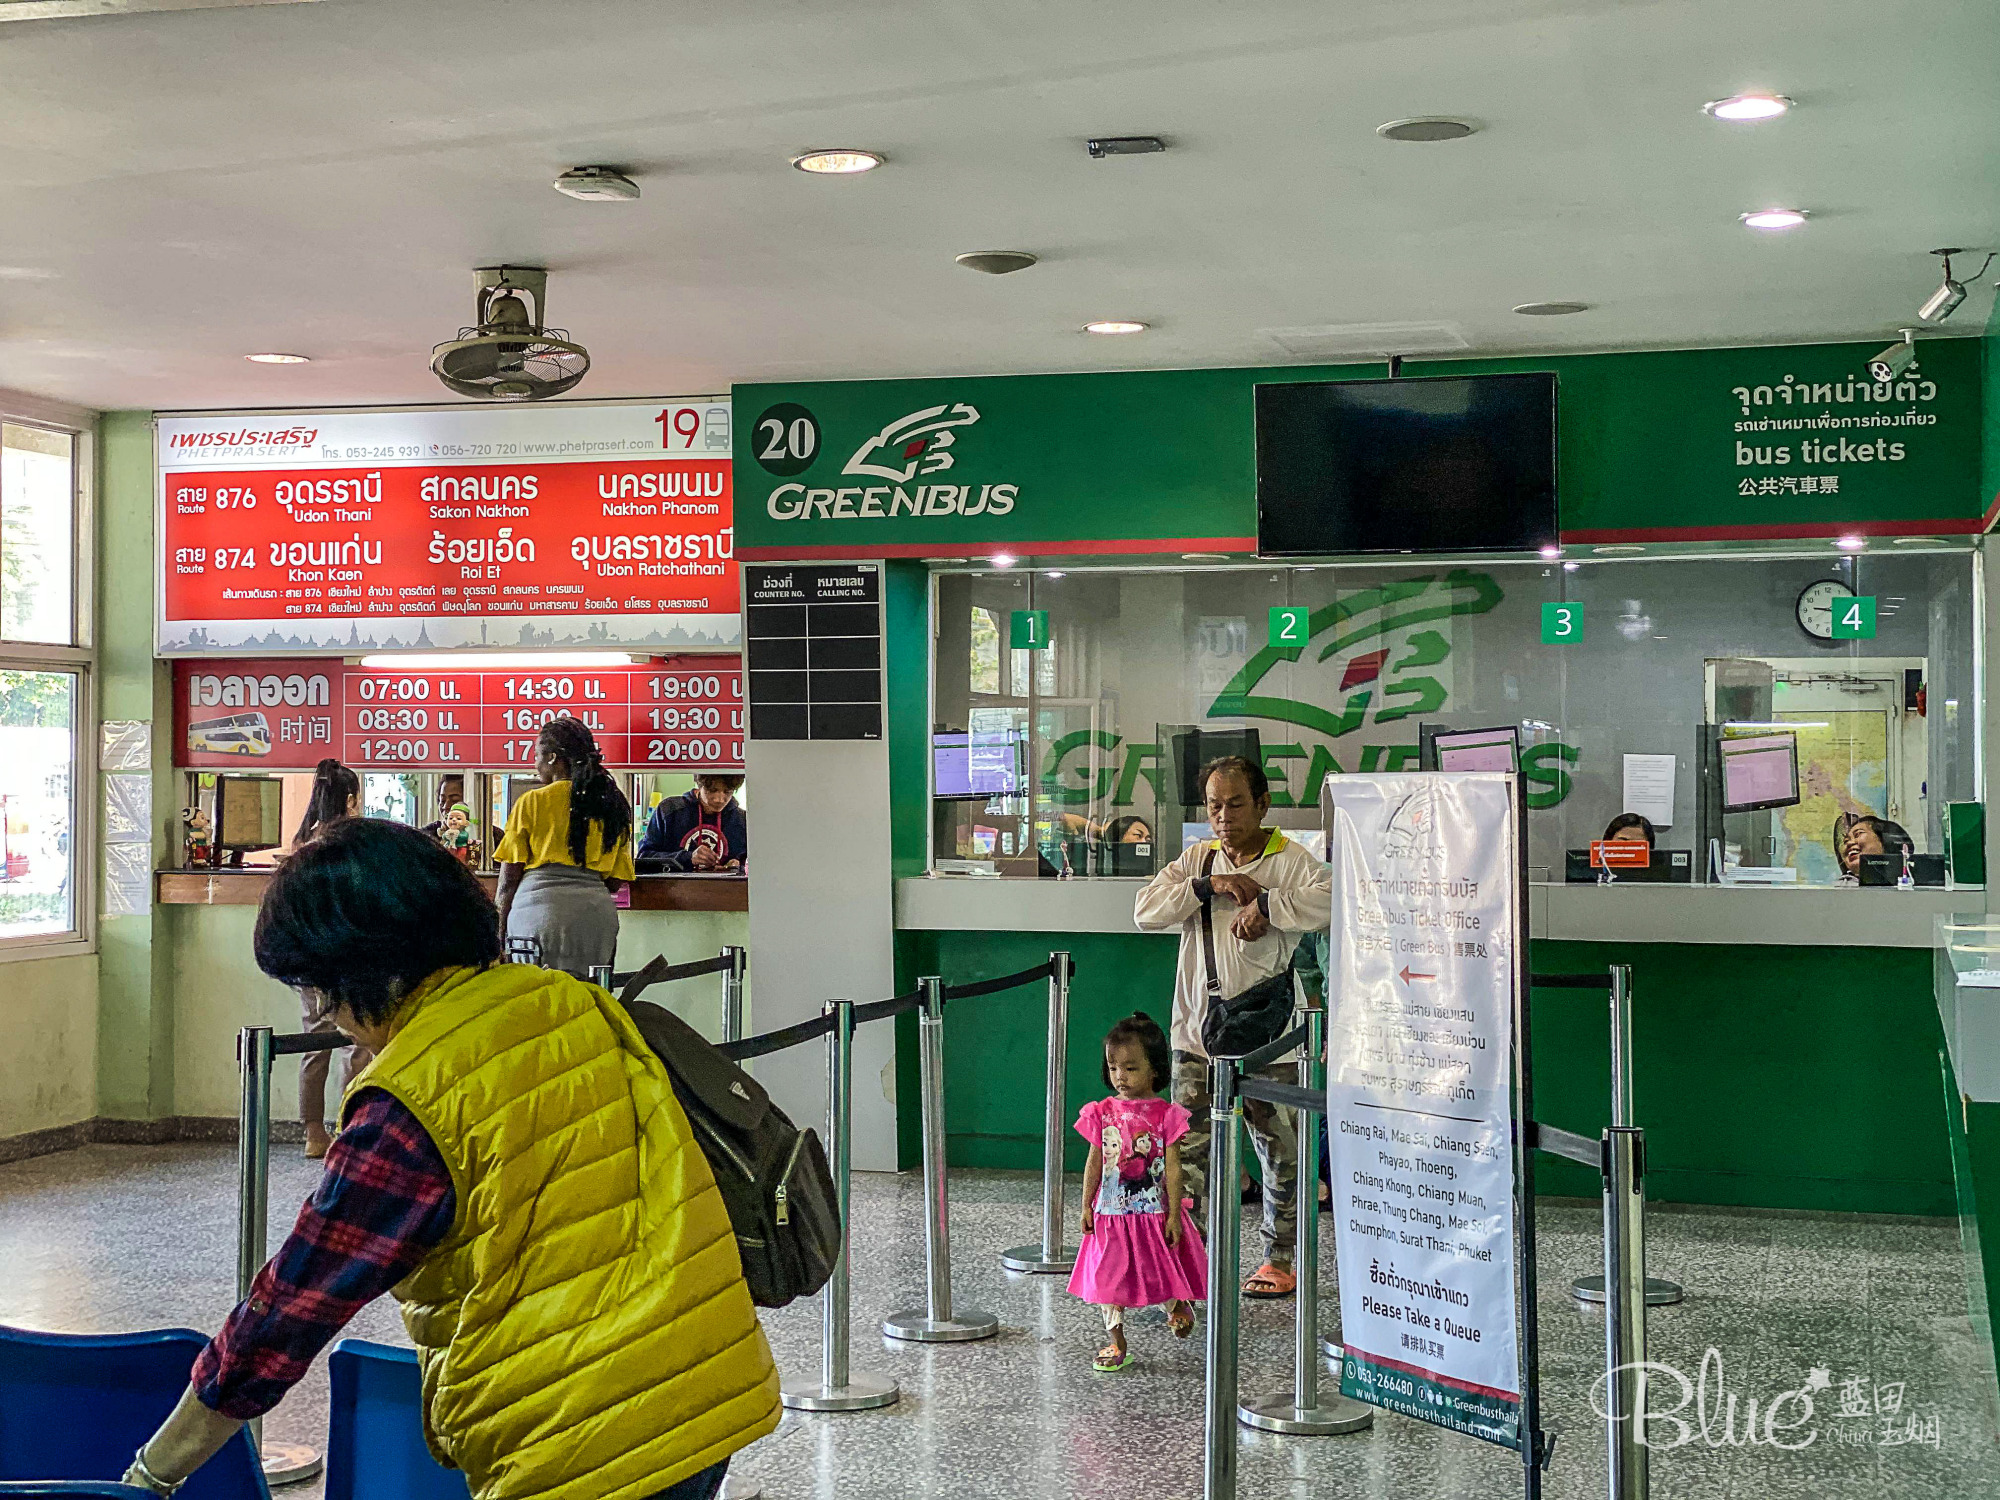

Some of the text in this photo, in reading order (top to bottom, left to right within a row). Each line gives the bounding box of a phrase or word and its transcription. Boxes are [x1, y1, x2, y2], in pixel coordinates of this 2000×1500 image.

[654, 408, 701, 449] 19
[759, 418, 815, 459] 20
[177, 445, 299, 459] PHETPRASERT
[346, 447, 394, 458] 053-245
[398, 446, 420, 457] 939
[442, 443, 517, 456] 056-720 720
[523, 439, 654, 454] www.phetprasert.com
[1736, 438, 1906, 465] bus tickets
[275, 471, 382, 514] อุดรธานี
[420, 474, 539, 501] สกลนคร
[598, 472, 724, 499] นครพนม
[1738, 476, 1839, 496] 公共汽車票
[176, 487, 257, 509] สาย 876
[177, 503, 205, 514] Route
[602, 501, 719, 516] Nakhon Phanom
[767, 483, 1019, 520] GREENBUS
[294, 507, 372, 522] Udon Thani
[429, 505, 529, 519] Sakon Nakhon
[270, 533, 382, 567] ขอนแก่น
[428, 527, 535, 564] ร้อยเอ็ด
[571, 527, 733, 570] อุบลราชธานี
[175, 547, 256, 569] สาย 874
[176, 564, 204, 574] Route
[597, 562, 725, 577] Ubon Ratchathani
[288, 568, 363, 582] Khon Kaen
[461, 565, 501, 579] Roi Et
[305, 588, 322, 597] 876
[305, 604, 322, 613] 874
[1841, 603, 1863, 631] 4
[1026, 617, 1036, 643] 1
[1280, 612, 1297, 639] 2
[1555, 609, 1572, 636] 3
[190, 674, 329, 707] เวลาออก
[359, 678, 461, 700] 07:00 น.
[504, 678, 606, 700] 14:30 น.
[648, 676, 720, 699] 19:00
[280, 715, 331, 744] 时间
[358, 709, 460, 730] 08:30 น.
[648, 707, 720, 730] 19:30
[360, 740, 460, 761] 12:00 น.
[648, 739, 720, 761] 20:00
[1358, 906, 1480, 929] Greenbus Ticket Office
[1340, 1121, 1371, 1141] Chiang
[1372, 1125, 1388, 1142] Rai,
[1391, 1129, 1411, 1144] Mae
[1433, 1136, 1471, 1157] Chiang
[1379, 1152, 1458, 1180] Phayao, Thoeng,
[1353, 1172, 1487, 1211] Chiang Khong, Chiang Muan,
[1351, 1195, 1381, 1215] Phrae,
[1382, 1201, 1407, 1222] Thung
[1409, 1208, 1445, 1229] Chang,
[1448, 1215, 1469, 1230] Mae
[1350, 1220, 1492, 1263] Chumphon, Surat Thani, Phuket
[1362, 1296, 1481, 1343] Please Take a Queue
[1357, 1366, 1413, 1396] 053-266480
